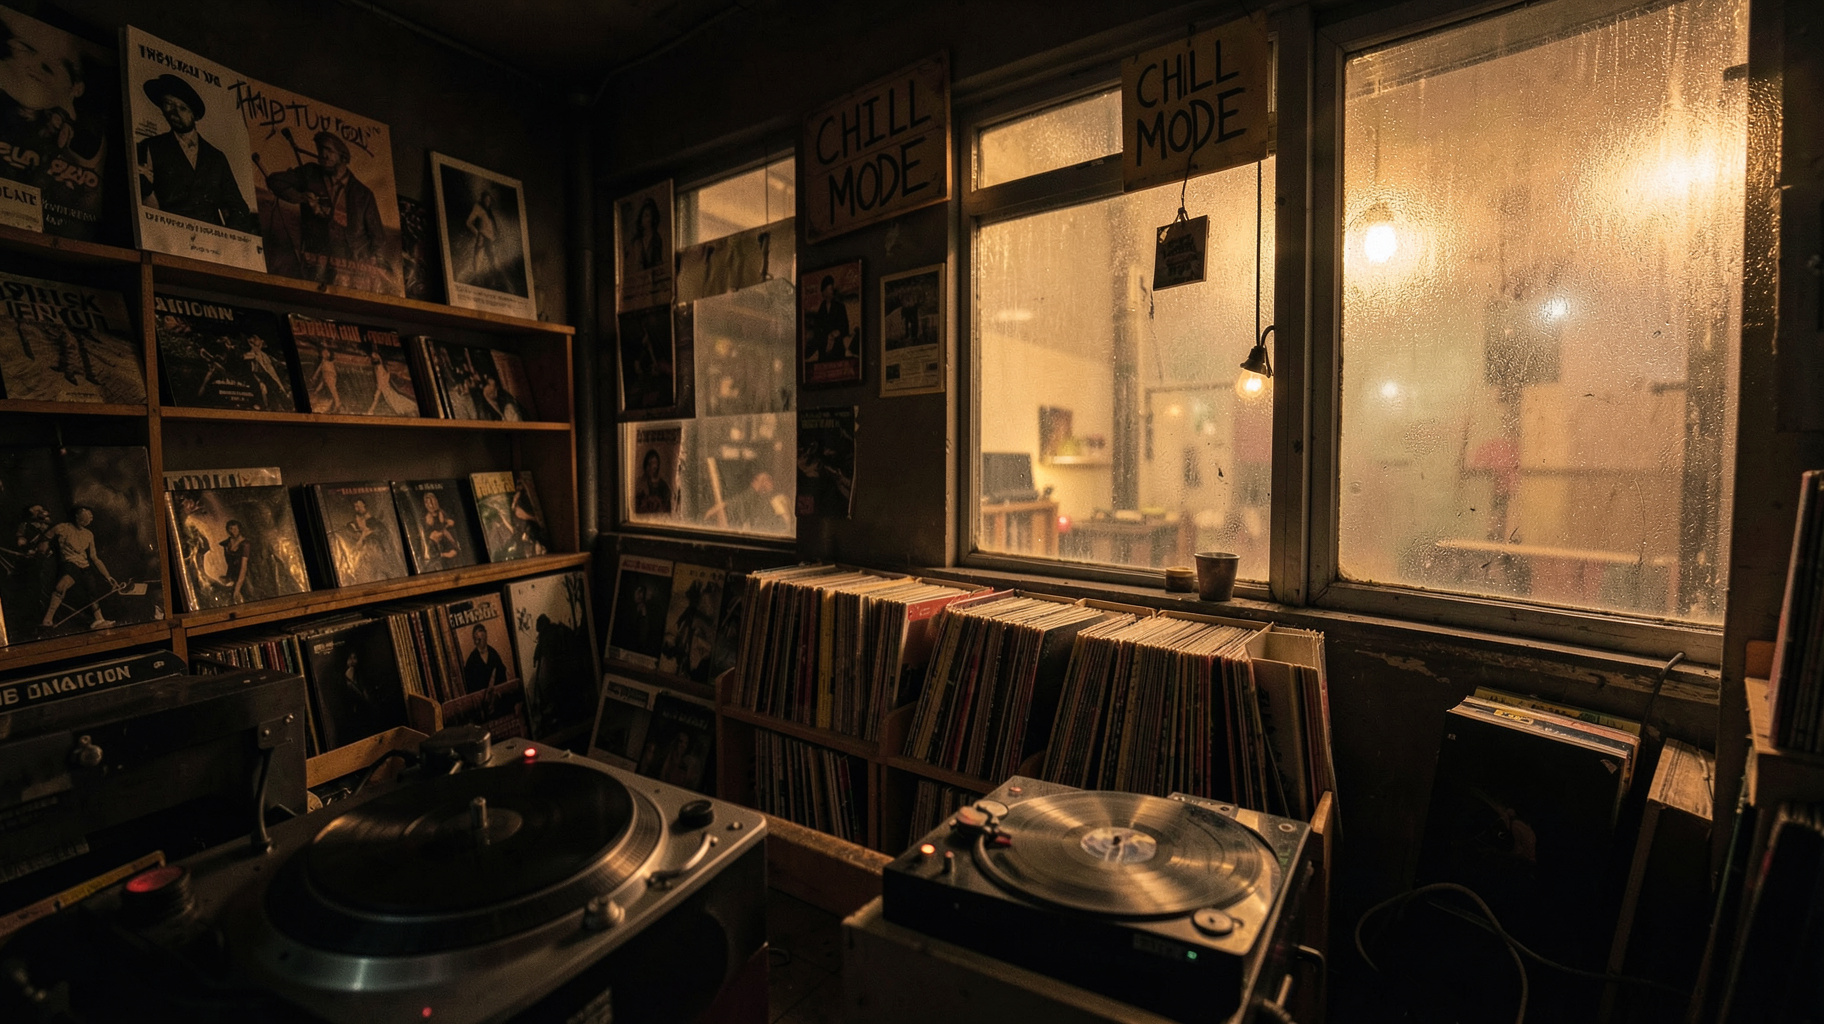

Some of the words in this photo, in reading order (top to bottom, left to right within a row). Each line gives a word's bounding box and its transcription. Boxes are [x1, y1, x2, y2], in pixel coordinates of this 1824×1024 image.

[1137, 40, 1239, 108] CHILL
[816, 79, 931, 165] CHILL
[1136, 87, 1246, 167] MODE
[828, 136, 930, 225] MODE
